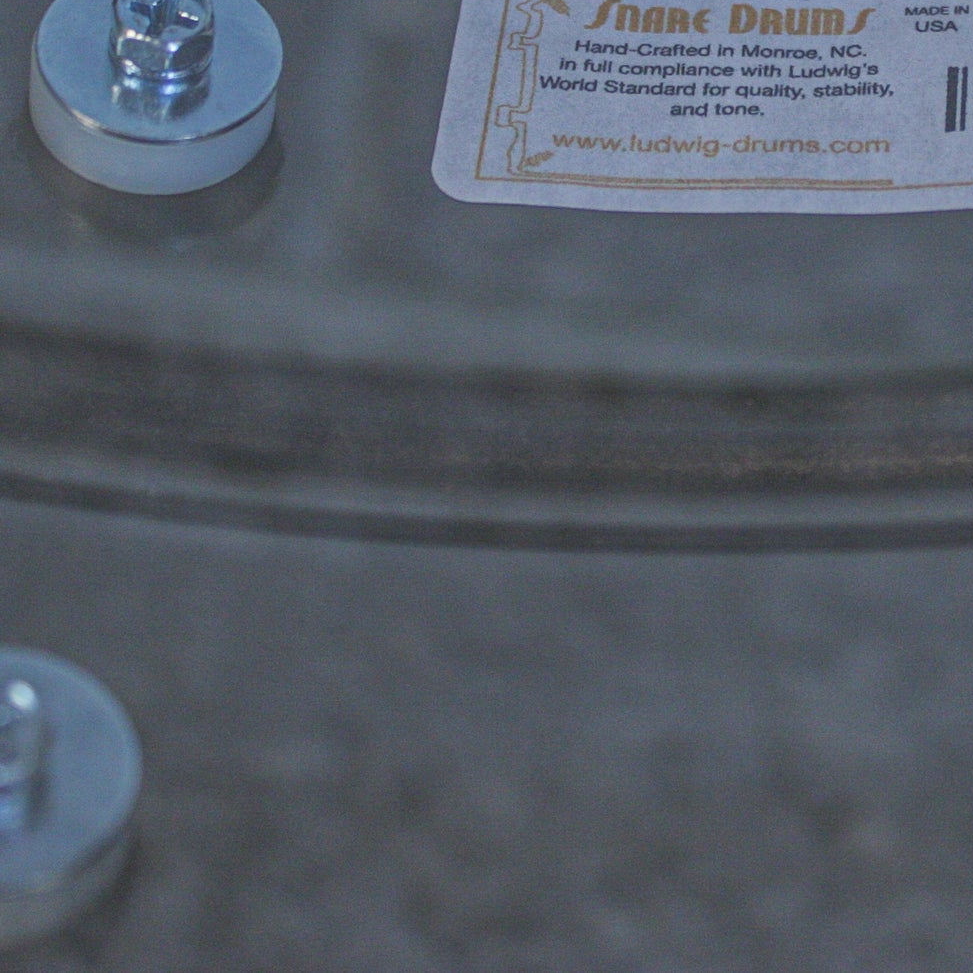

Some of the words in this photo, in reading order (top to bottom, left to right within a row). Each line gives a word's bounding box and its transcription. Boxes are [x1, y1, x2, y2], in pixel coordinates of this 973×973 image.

[904, 5, 950, 18] MADE
[953, 3, 970, 16] IN
[915, 20, 959, 33] USA
[574, 39, 711, 58] Hand-Crafted
[717, 44, 734, 58] in
[741, 44, 822, 61] Monroe,
[830, 43, 867, 59] NC.
[559, 57, 578, 71] in
[584, 58, 613, 74] full
[618, 60, 734, 79] compliance
[741, 63, 782, 78] with
[788, 62, 879, 80] Ludwig's
[539, 75, 598, 93] World
[604, 78, 696, 97] Standard
[702, 82, 729, 97] for
[735, 83, 806, 101] quality,
[812, 82, 895, 98] stability,
[669, 102, 709, 117] and
[714, 102, 765, 117] tone.
[552, 134, 891, 158] www.ludwig-drums.com
